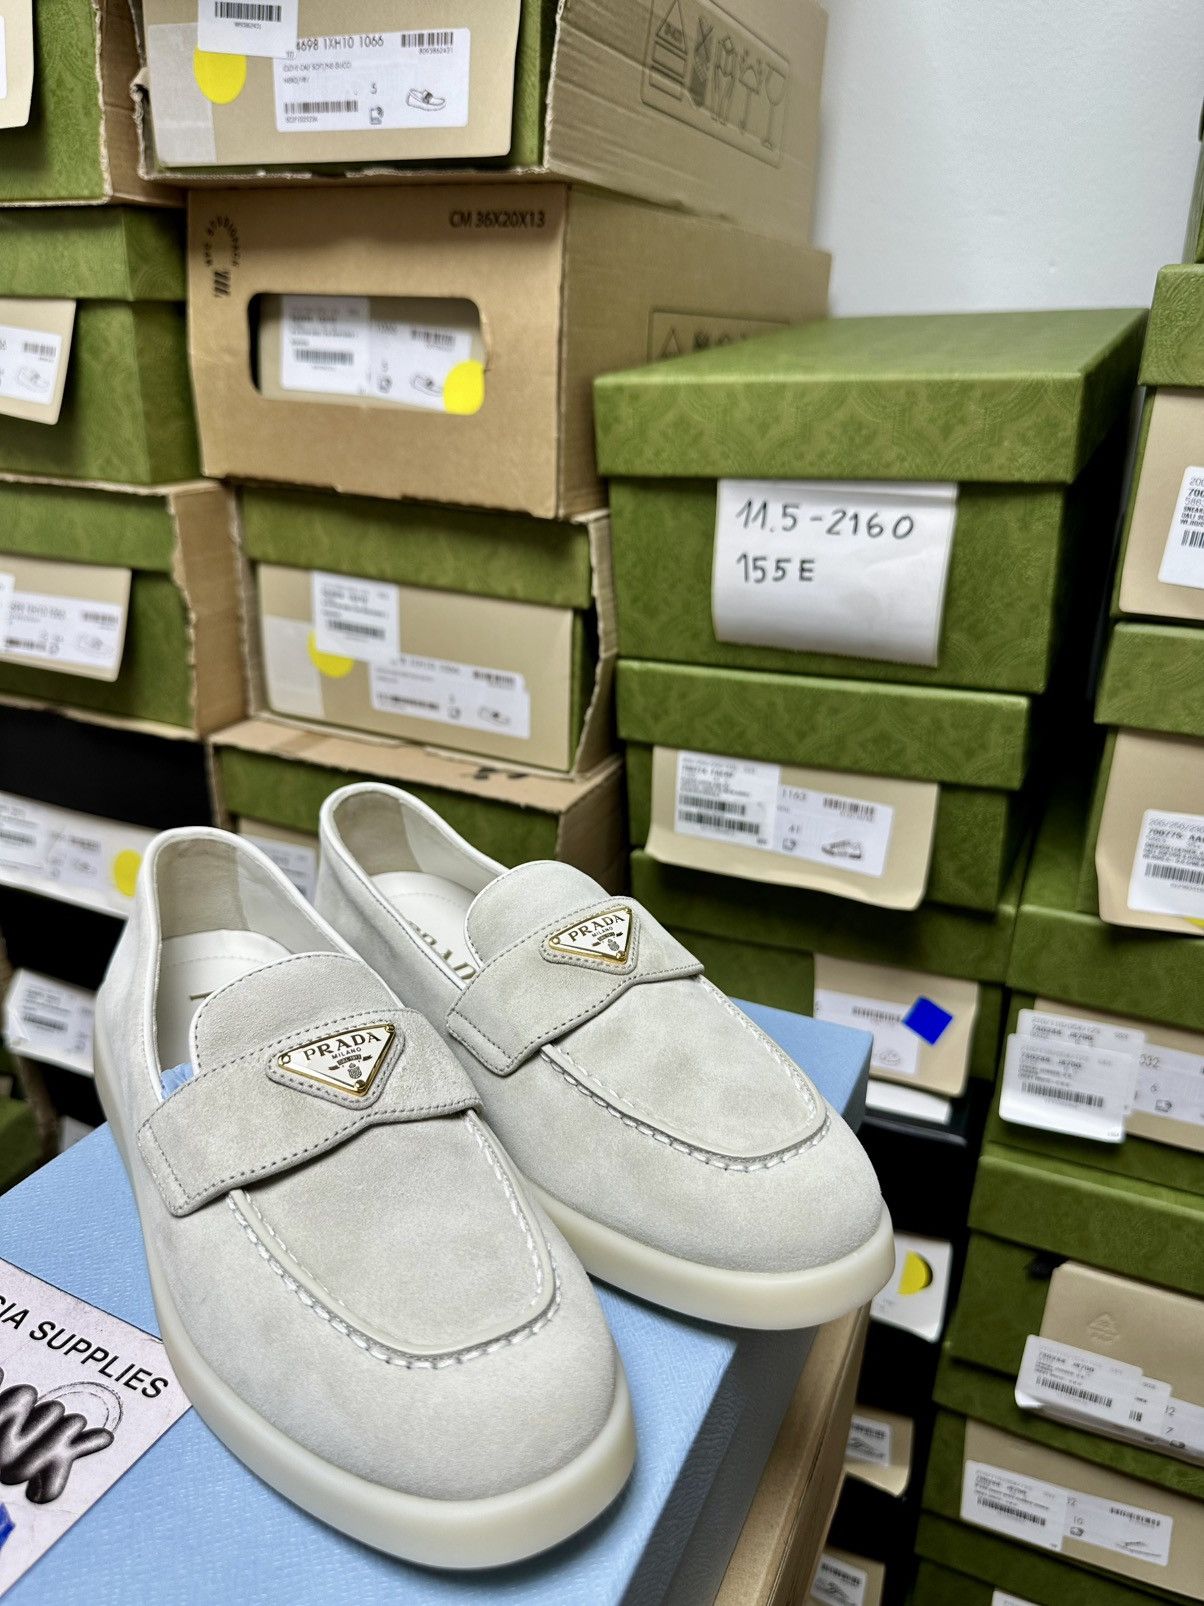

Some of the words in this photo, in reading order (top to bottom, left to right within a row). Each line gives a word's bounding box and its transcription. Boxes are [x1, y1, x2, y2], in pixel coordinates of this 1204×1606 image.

[360, 35, 384, 48] 1066
[449, 209, 472, 229] CM
[474, 208, 546, 229] 36X20X13
[567, 914, 626, 942] PRADA
[591, 926, 614, 938] MILANO
[303, 1032, 382, 1061] PRADA
[331, 1046, 362, 1060] MILANO
[29, 1321, 169, 1399] SUPPLIES
